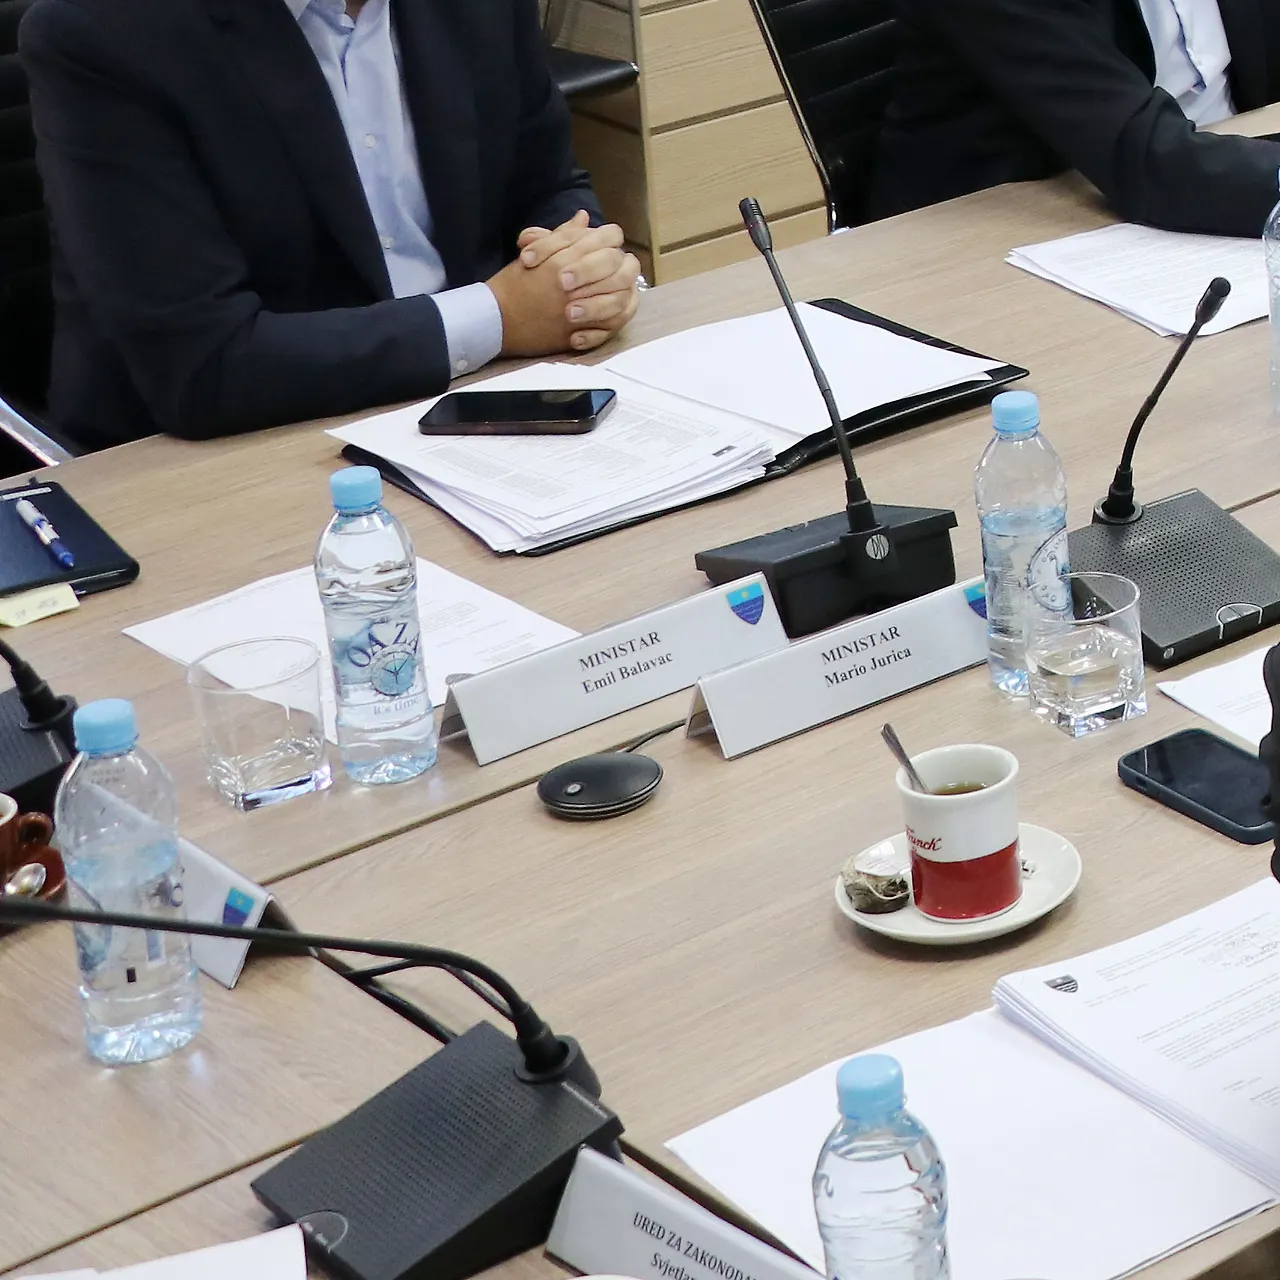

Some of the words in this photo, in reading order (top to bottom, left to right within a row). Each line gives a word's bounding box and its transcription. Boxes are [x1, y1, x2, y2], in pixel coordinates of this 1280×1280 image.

[579, 631, 661, 672] MINISTAR
[821, 626, 901, 666] MINISTAR
[581, 671, 617, 694] Emil
[618, 652, 673, 681] Balavac
[824, 663, 867, 689] Mario
[870, 647, 912, 671] Jurica
[633, 1211, 666, 1240] URED
[666, 1231, 682, 1252] ZA
[683, 1240, 758, 1280] ZAKONOD
